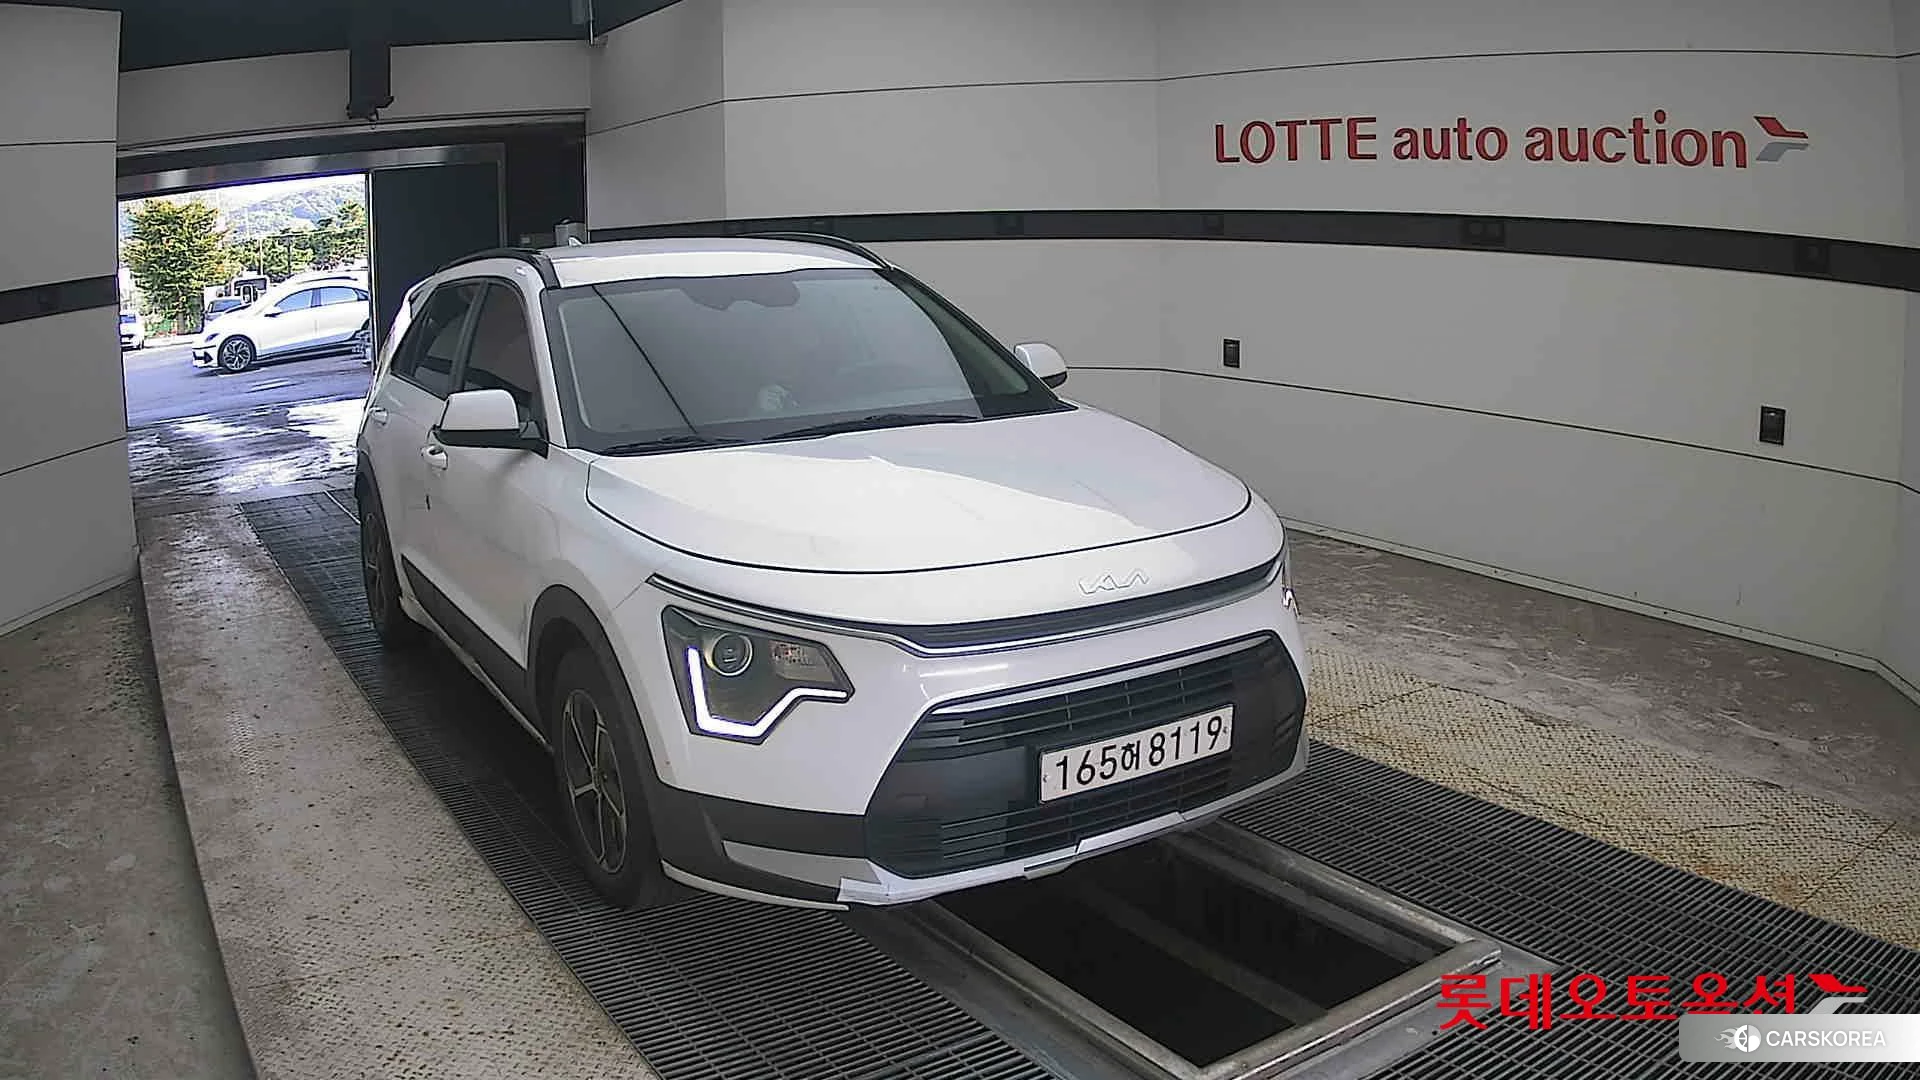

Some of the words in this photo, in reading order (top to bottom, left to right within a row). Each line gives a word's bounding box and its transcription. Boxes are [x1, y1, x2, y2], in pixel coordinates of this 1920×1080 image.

[1214, 116, 1378, 164] LOTTE
[1392, 117, 1509, 162] auto
[1524, 109, 1748, 169] auction
